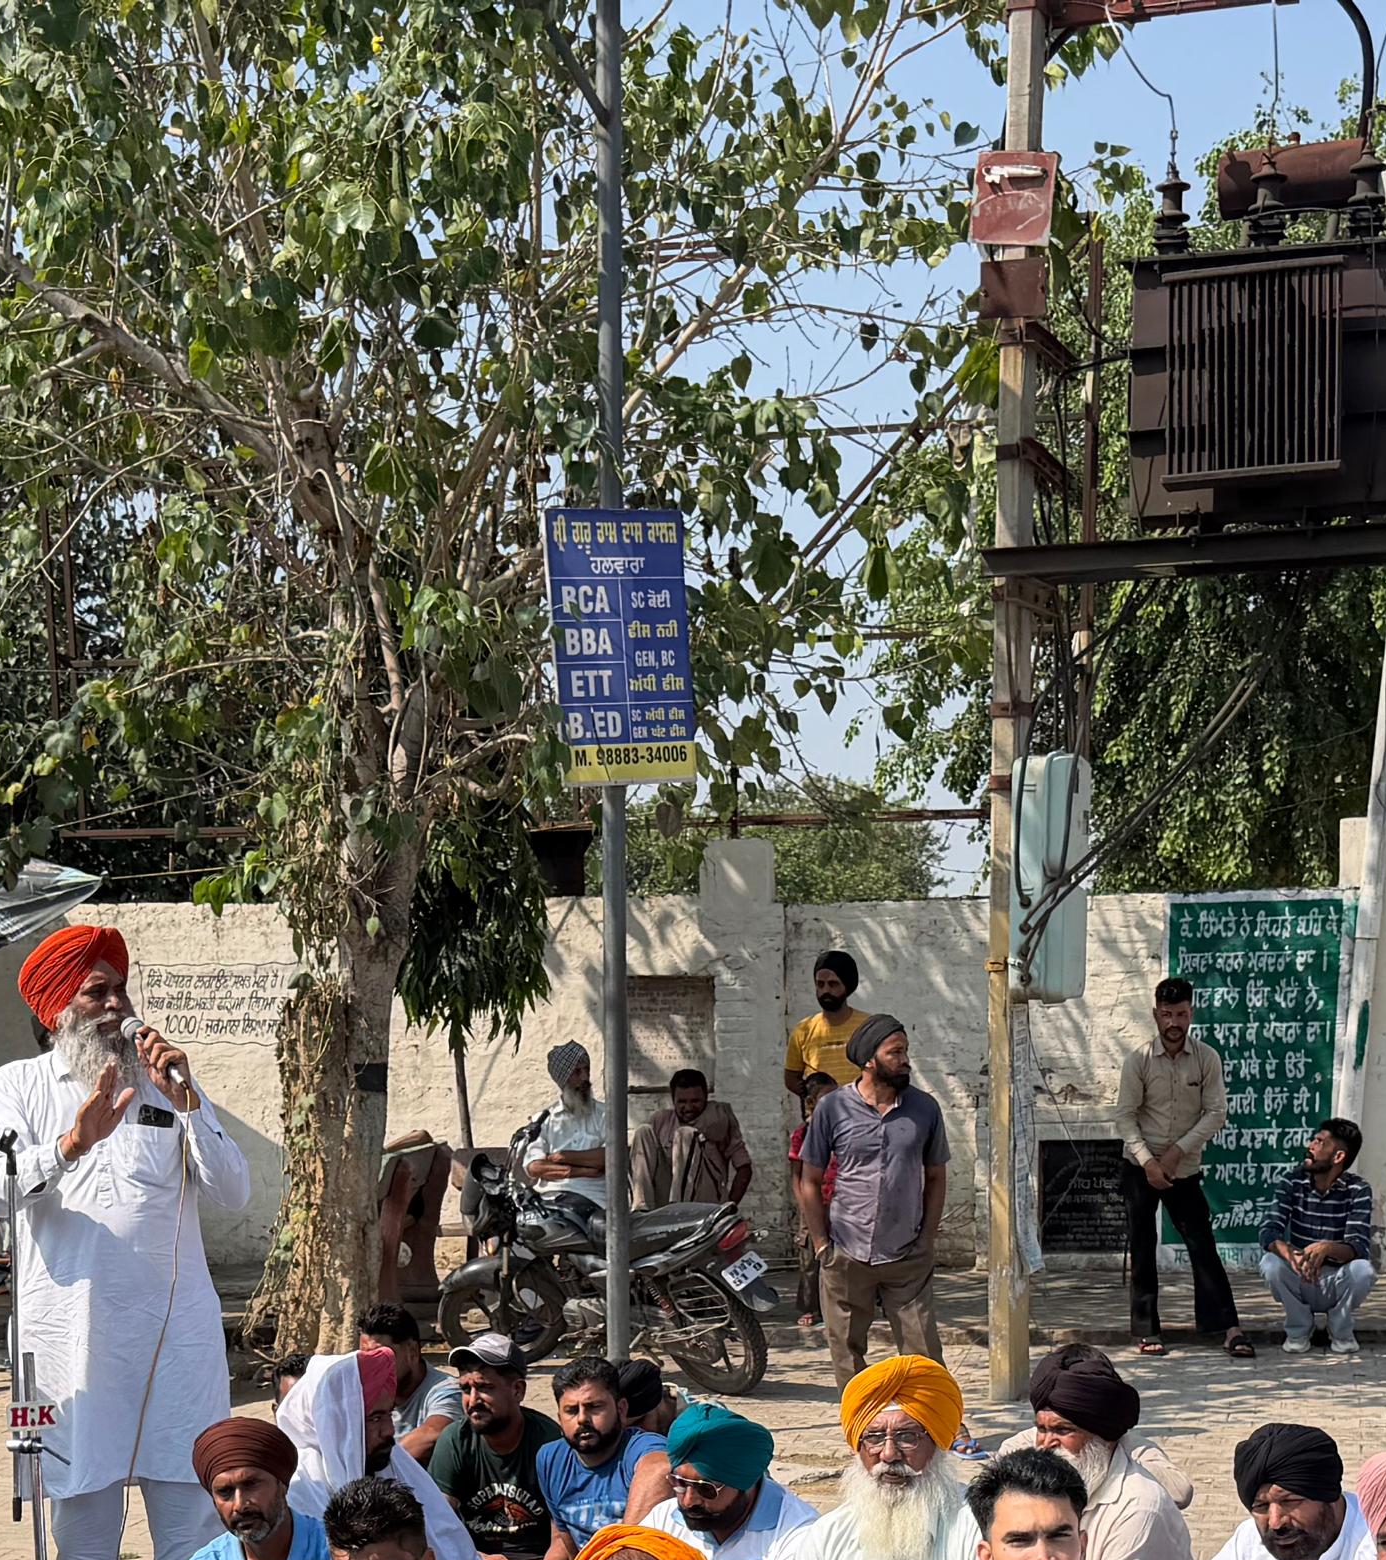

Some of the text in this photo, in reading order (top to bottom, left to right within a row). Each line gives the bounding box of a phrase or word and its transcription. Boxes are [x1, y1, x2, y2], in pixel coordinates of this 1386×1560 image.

[571, 522, 592, 555] ਗੁਰੂ
[595, 522, 618, 543] ਰਾਮ
[621, 522, 643, 543] ਦਾਸ
[646, 522, 678, 543] ਕਾਲਜ
[590, 557, 645, 575] ਹਲਵਾਰਾ
[561, 585, 611, 614] BCA
[631, 589, 671, 609] SC ਕੋਈ
[565, 628, 613, 656] BBA
[661, 649, 676, 667] BC
[570, 670, 613, 697] ETT
[569, 711, 622, 739] B.ED
[631, 710, 642, 722] SC
[633, 726, 648, 740] GEN
[597, 744, 687, 766] 98883-34006
